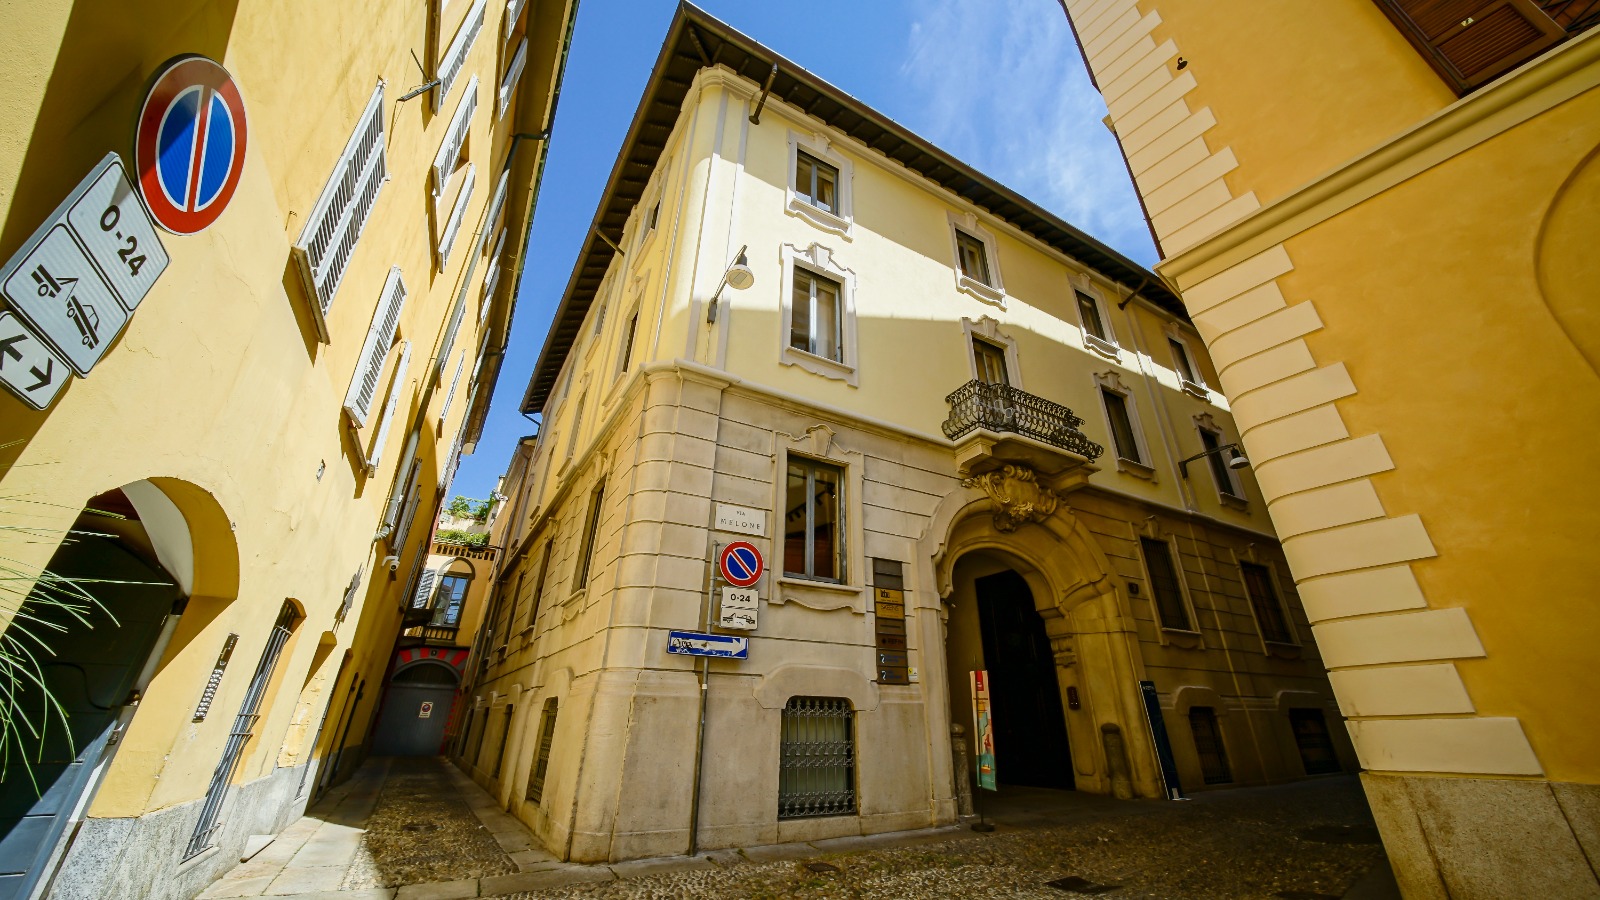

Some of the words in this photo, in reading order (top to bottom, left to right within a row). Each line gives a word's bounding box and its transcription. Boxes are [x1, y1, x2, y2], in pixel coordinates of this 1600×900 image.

[100, 204, 147, 277] 0-24
[720, 518, 761, 530] MELONE
[730, 593, 751, 602] 0-24
